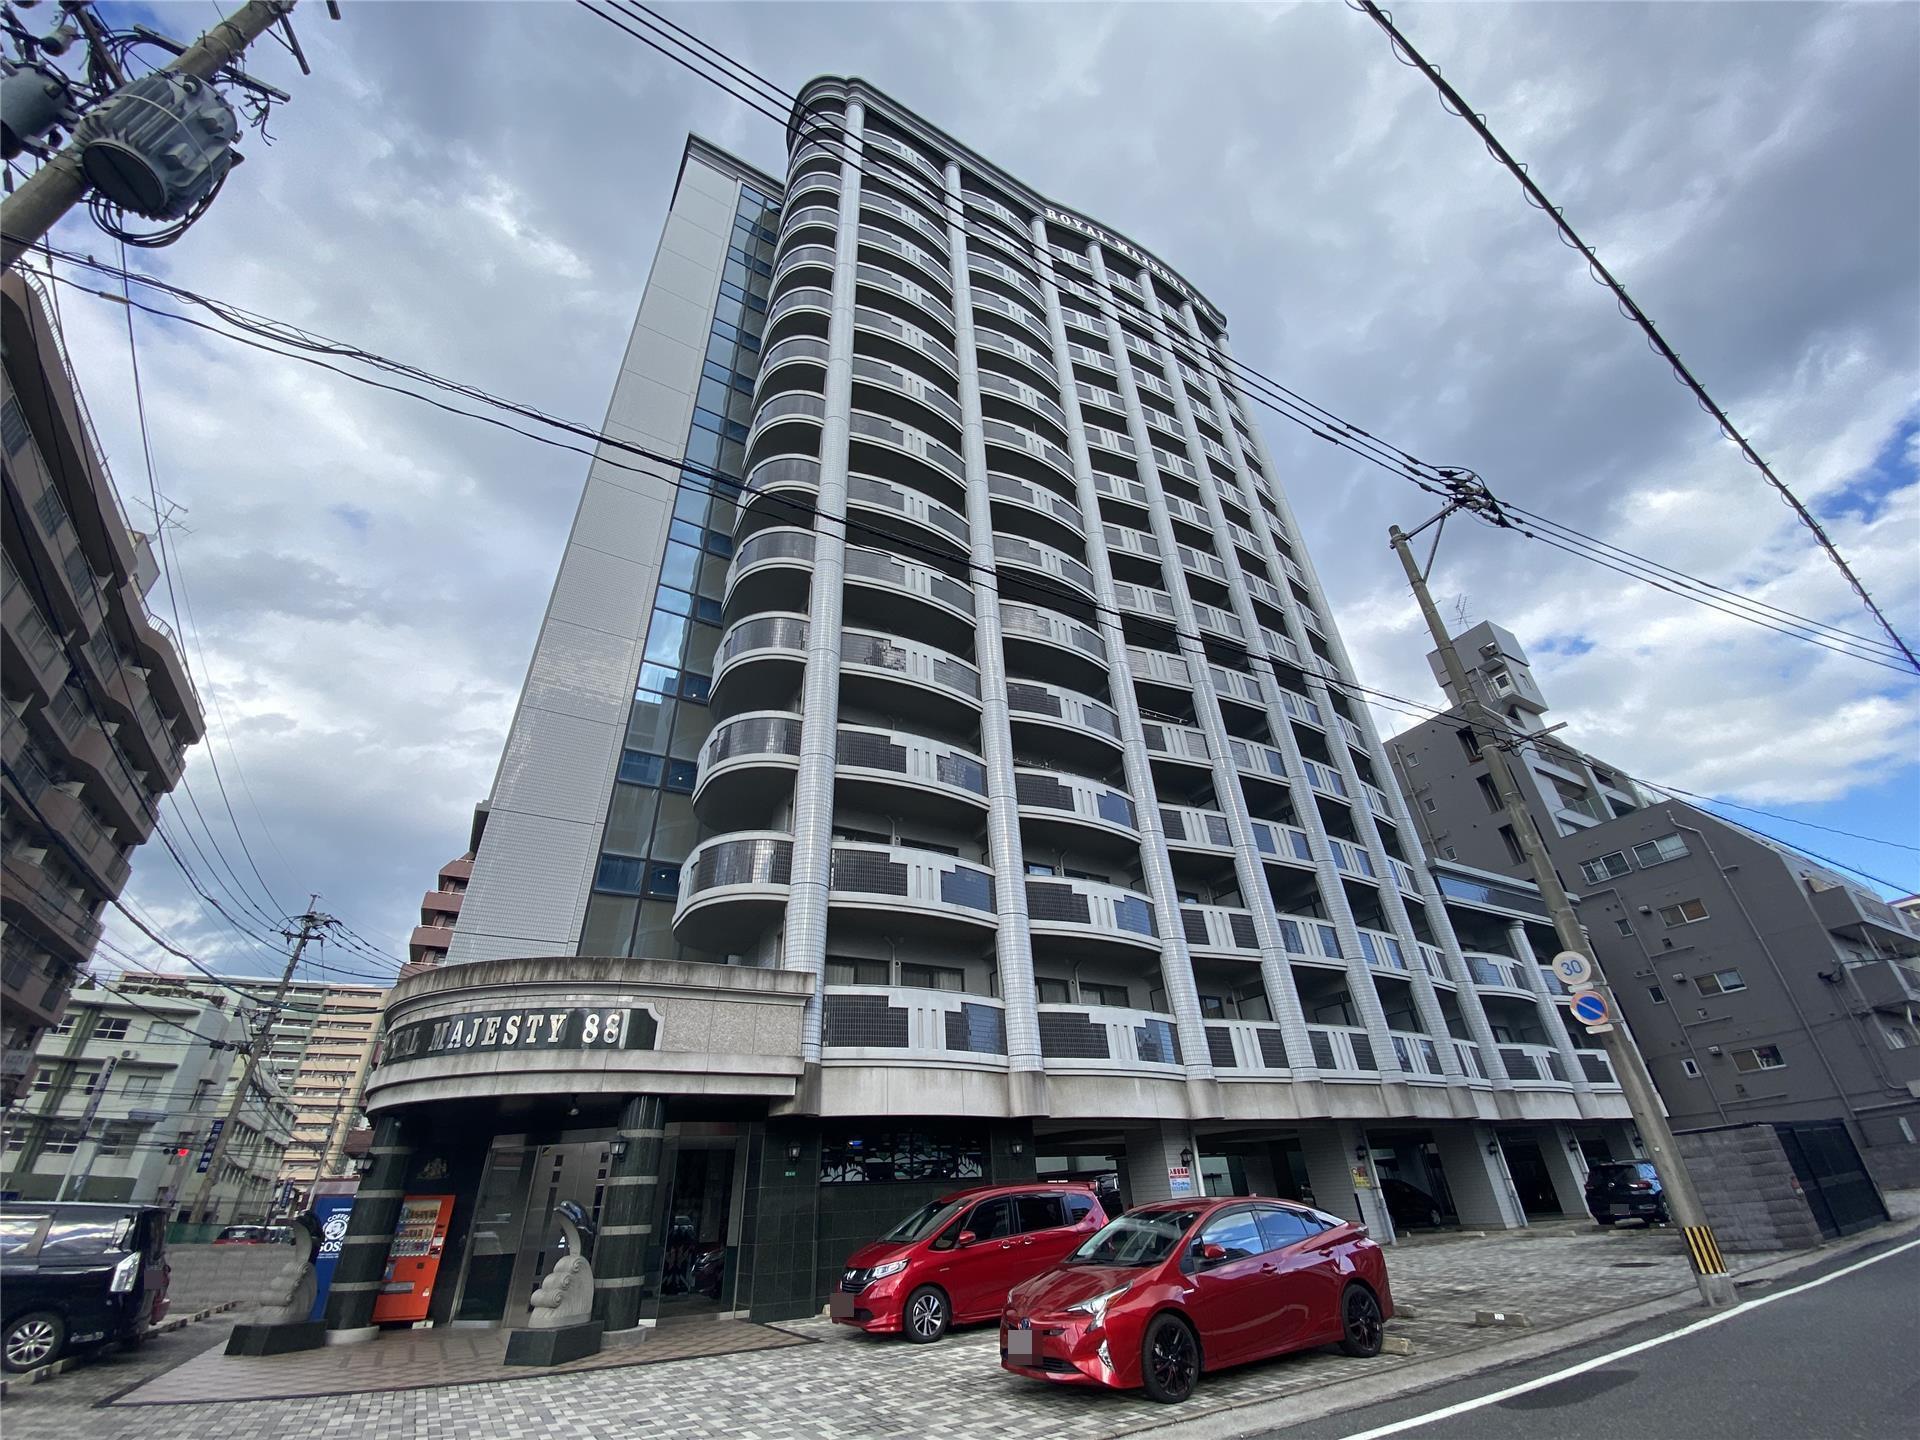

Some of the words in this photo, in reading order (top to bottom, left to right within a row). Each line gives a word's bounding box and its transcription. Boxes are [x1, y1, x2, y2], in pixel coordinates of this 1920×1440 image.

[1045, 208, 1108, 243] ROYAL
[1115, 240, 1189, 297] MAJESTY
[1561, 960, 1583, 976] 30
[428, 1014, 567, 1052] MAJESTY
[582, 1013, 621, 1044] 88
